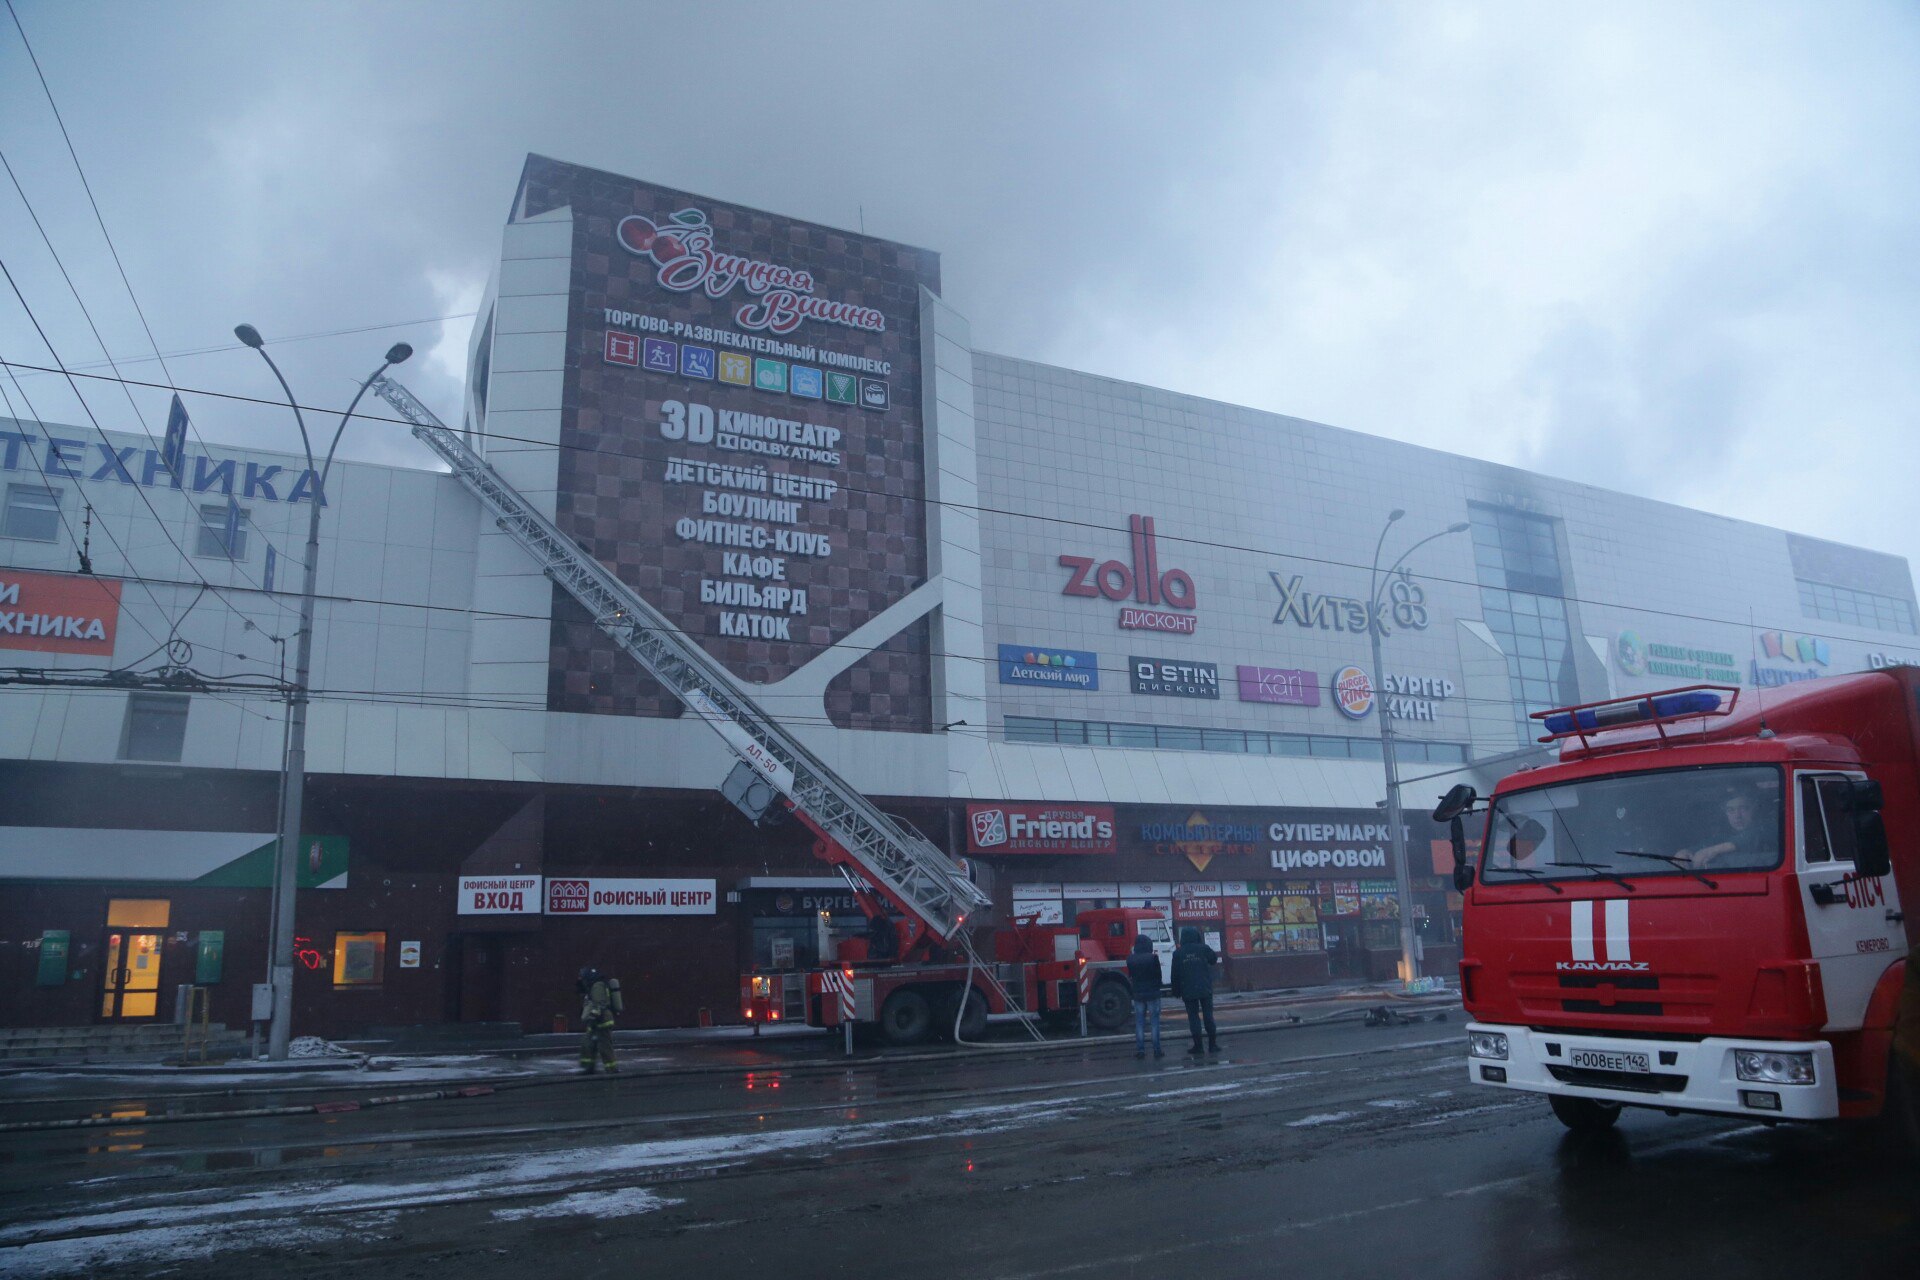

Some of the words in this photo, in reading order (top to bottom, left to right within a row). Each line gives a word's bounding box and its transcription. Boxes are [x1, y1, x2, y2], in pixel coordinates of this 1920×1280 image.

[735, 289, 886, 335] Вишня
[604, 308, 815, 362] ТОРГОВО-РАЗВЛЕКАТЕЛЬНЫЙ
[819, 350, 891, 376] КОМПЛЕКС
[660, 399, 714, 444] 3D
[719, 409, 841, 449] КИНОТЕАТР
[740, 439, 790, 458] DOLBY
[791, 446, 841, 465] ATMOS
[0, 431, 328, 507] ТЕХНИКА
[664, 456, 767, 492] ДЕТСКИЙ
[773, 471, 838, 501] ЦЕНТР
[703, 491, 802, 524] БОУЛИНГ
[675, 517, 832, 557] ФИТНЕС-КЛУБ
[723, 552, 786, 581] КАФЕ
[1058, 513, 1197, 610] zolla
[700, 579, 807, 615] БИЛЬЯРД
[719, 612, 791, 641] КАТОК
[1122, 610, 1196, 632] ДИСКОНТ
[1011, 665, 1062, 682] Детский
[1065, 669, 1090, 686] мир
[1256, 666, 1303, 697] kari
[1338, 675, 1369, 693] BURGER
[1383, 673, 1455, 698] БУРГЕР
[1340, 685, 1371, 708] KING
[746, 744, 778, 773] АЛ-50
[1009, 813, 1113, 840] Friend's
[1269, 823, 1411, 842] СУПЕРМАРКТ
[1271, 845, 1386, 872] ЦИФРОВОЙ
[464, 879, 507, 890] ОФИСНЫЙ
[510, 879, 535, 890] ЦЕНТР
[474, 892, 524, 912] ВХОД
[552, 899, 558, 910] 3
[560, 899, 587, 910] ЭТАЖ
[593, 889, 669, 906] ОФИСНЫЙ
[670, 891, 712, 908] ЦЕНТР
[1856, 937, 1890, 954] КЕМЕРОВО
[1625, 1055, 1646, 1068] 142
